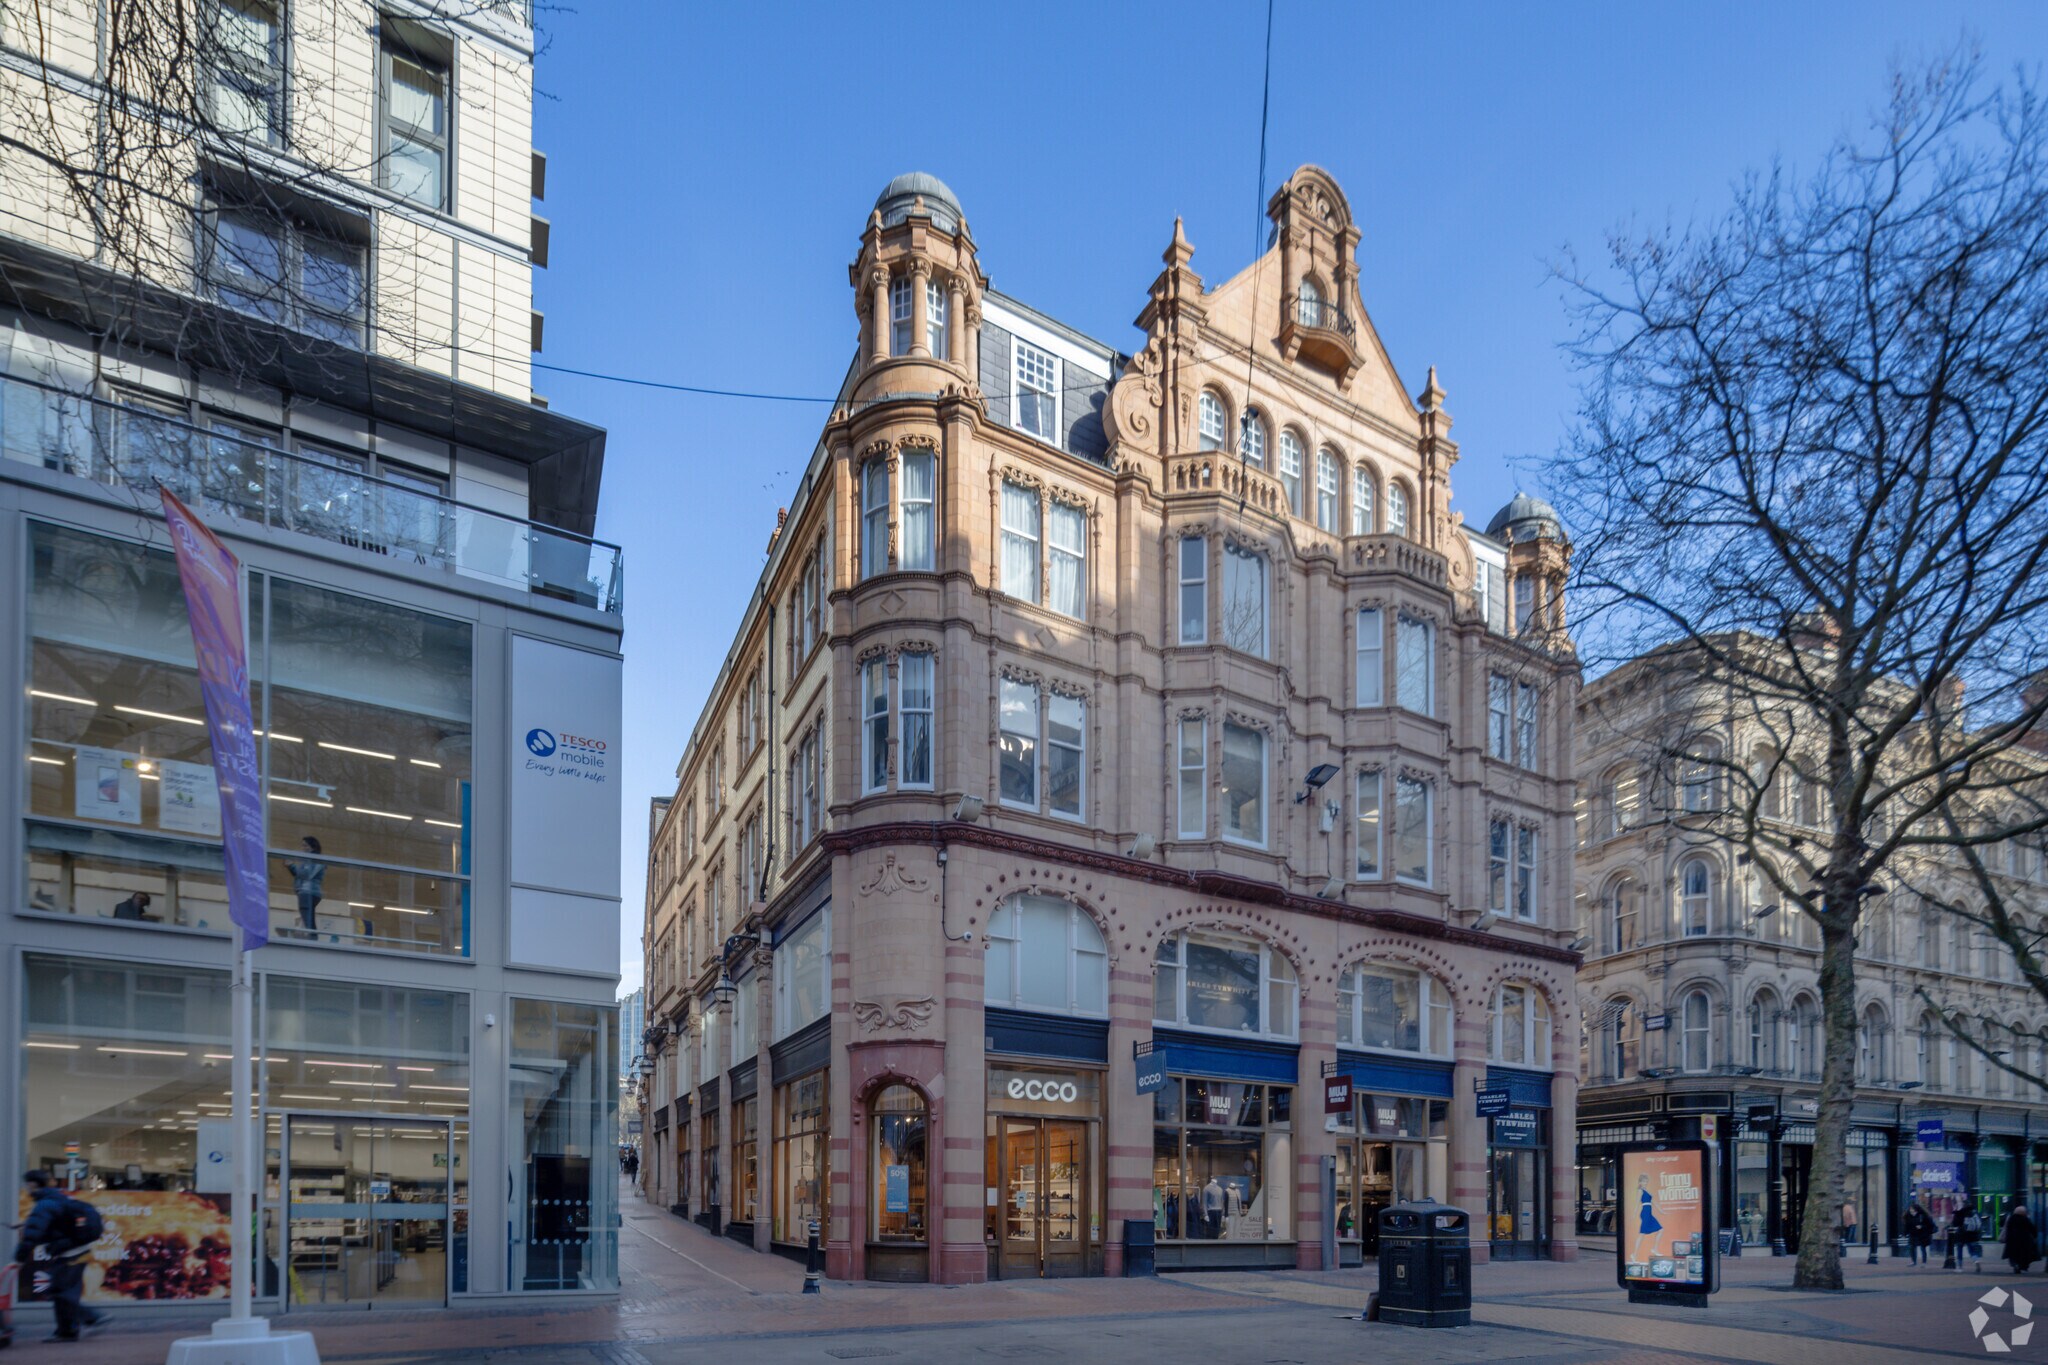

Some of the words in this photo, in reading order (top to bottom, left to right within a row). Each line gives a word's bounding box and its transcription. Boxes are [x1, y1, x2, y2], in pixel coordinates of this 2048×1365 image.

[559, 733, 607, 751] TESCO
[561, 752, 604, 768] mobile
[525, 758, 555, 777] Every
[558, 766, 582, 778] little
[584, 771, 607, 783] helps
[1187, 980, 1211, 989] ARLES
[1138, 1072, 1162, 1087] ecco
[1007, 1078, 1077, 1103] ecco
[1329, 1085, 1348, 1098] MUJI
[1209, 1096, 1231, 1109] MUJI
[1378, 1108, 1397, 1120] MUJI
[1495, 1119, 1537, 1128] TYRWHITT
[1660, 1171, 1692, 1189] funny
[1658, 1187, 1699, 1201] woman
[1652, 1263, 1673, 1275] sky
